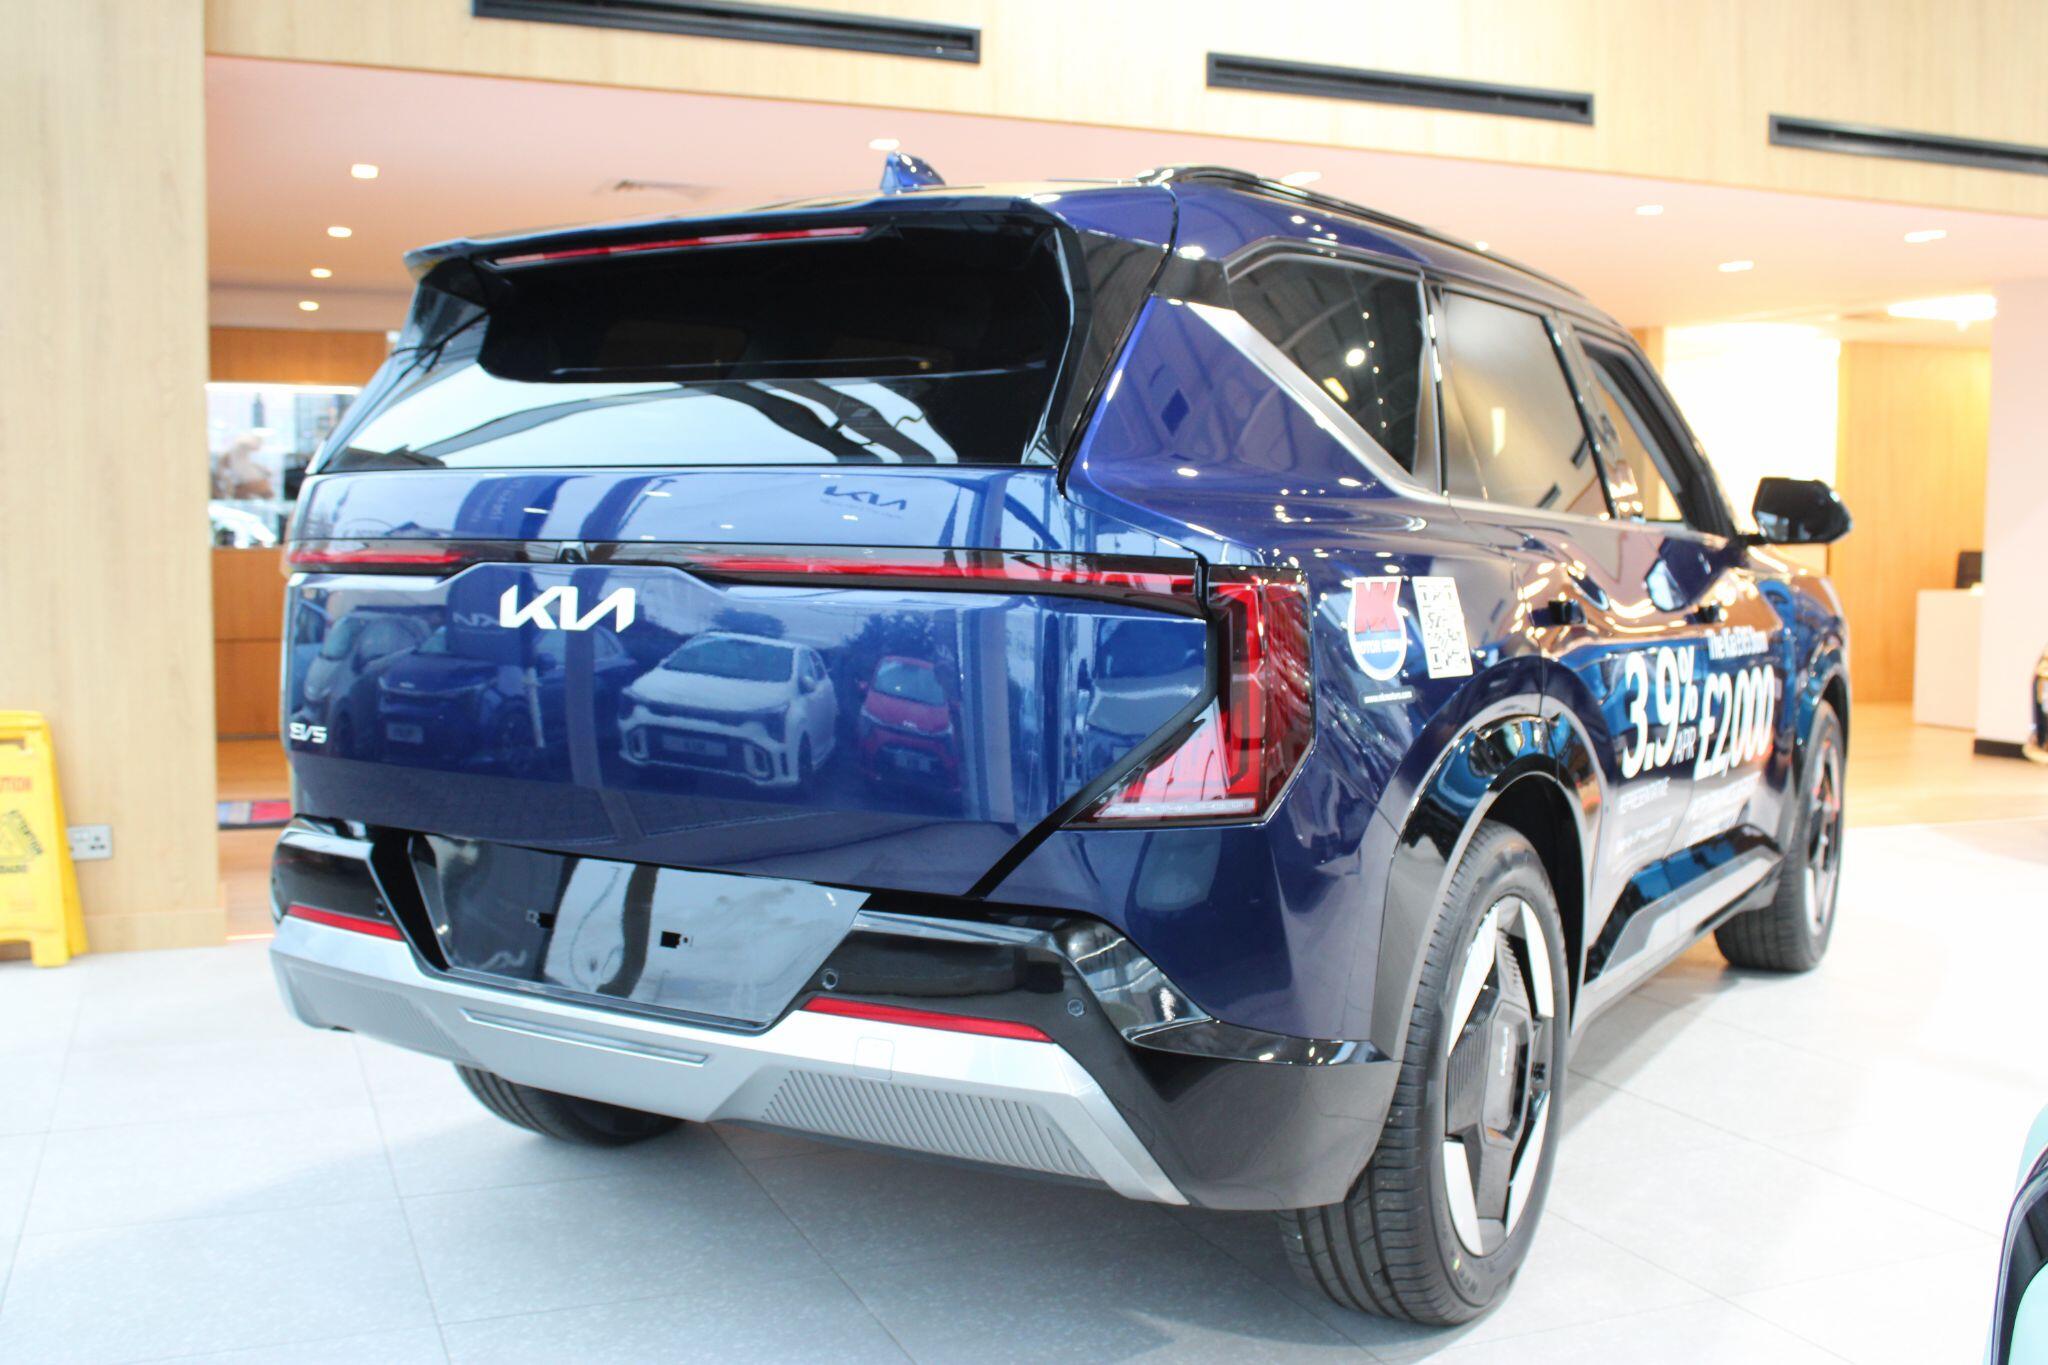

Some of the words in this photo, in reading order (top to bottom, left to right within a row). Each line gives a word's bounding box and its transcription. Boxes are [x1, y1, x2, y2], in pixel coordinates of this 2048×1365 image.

[500, 584, 635, 633] KIA
[1622, 645, 1698, 779] 3.9%
[1671, 726, 1697, 766] APR
